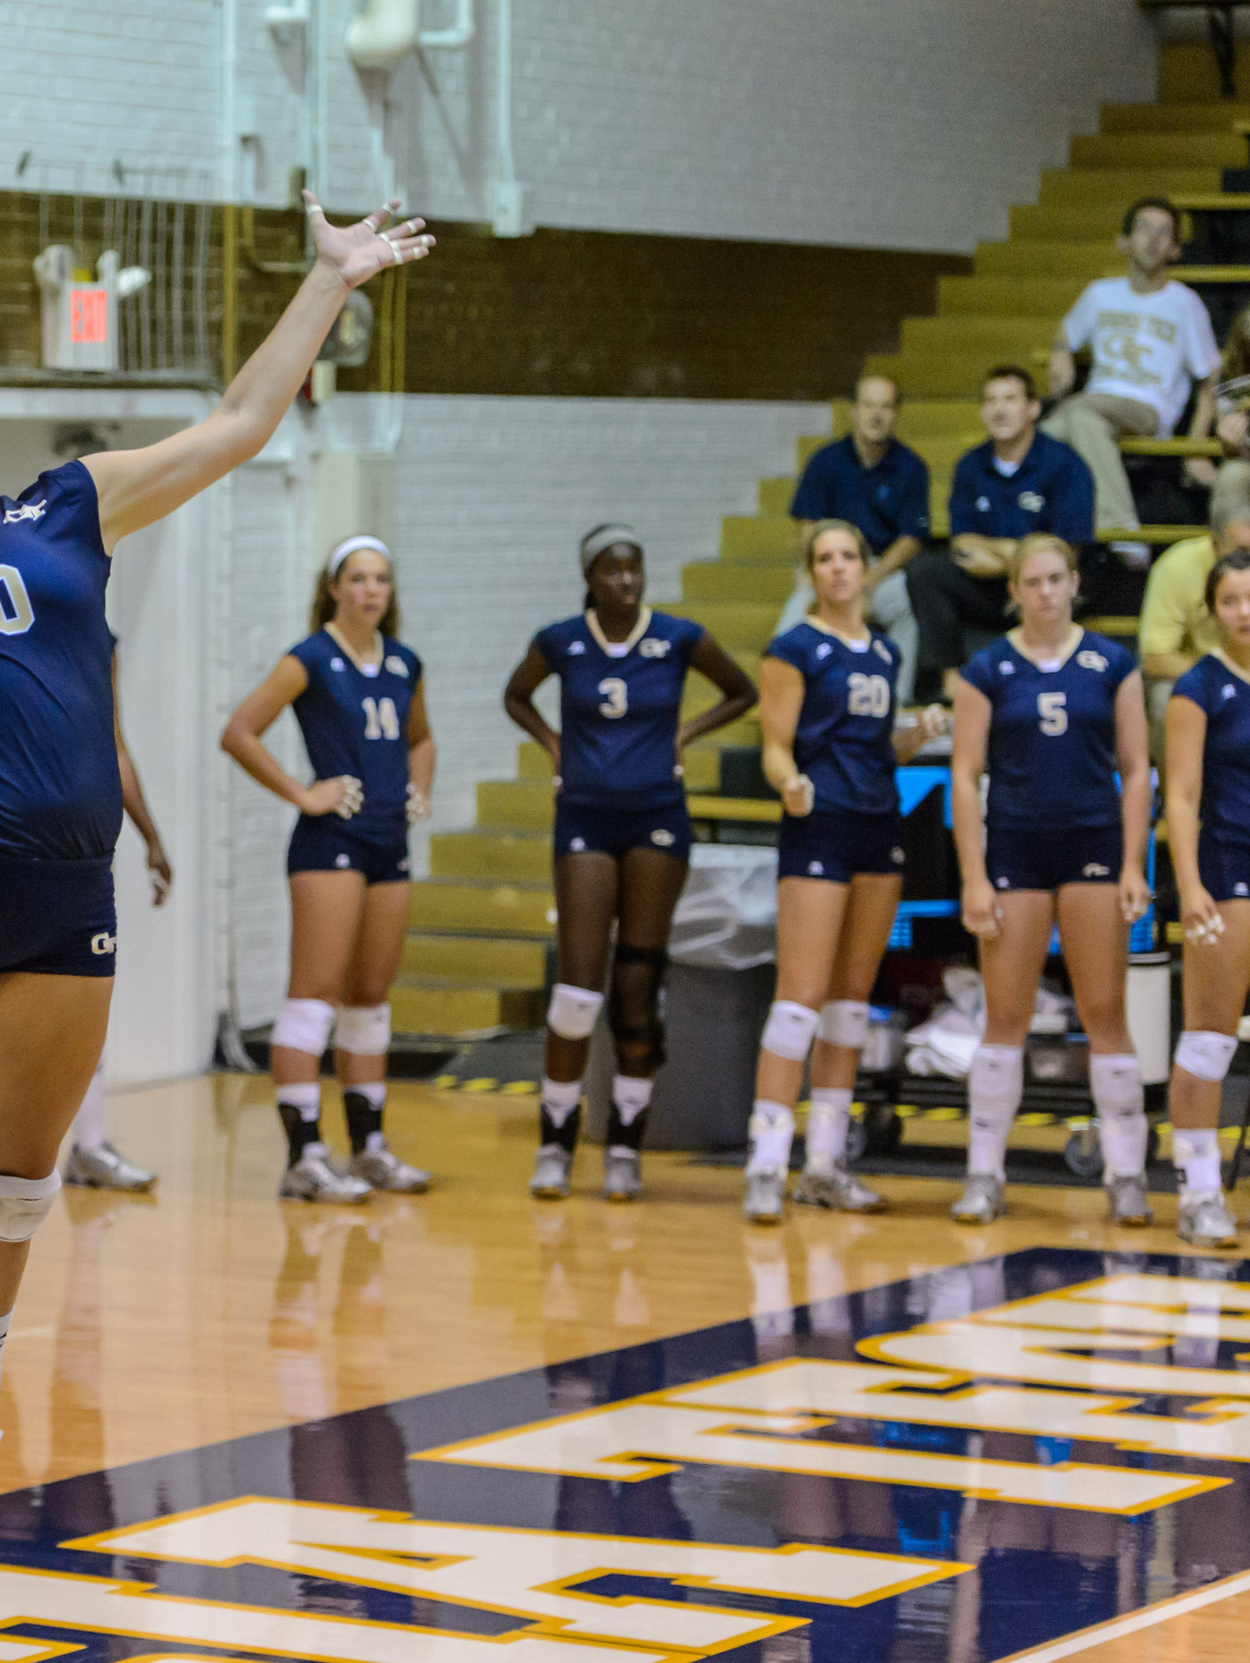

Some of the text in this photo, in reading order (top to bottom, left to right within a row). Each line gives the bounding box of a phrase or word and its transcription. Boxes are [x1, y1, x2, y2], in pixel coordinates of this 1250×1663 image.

[598, 677, 628, 719] 3
[847, 672, 890, 718] 20
[1036, 691, 1068, 736] 5
[362, 696, 400, 740] 14
